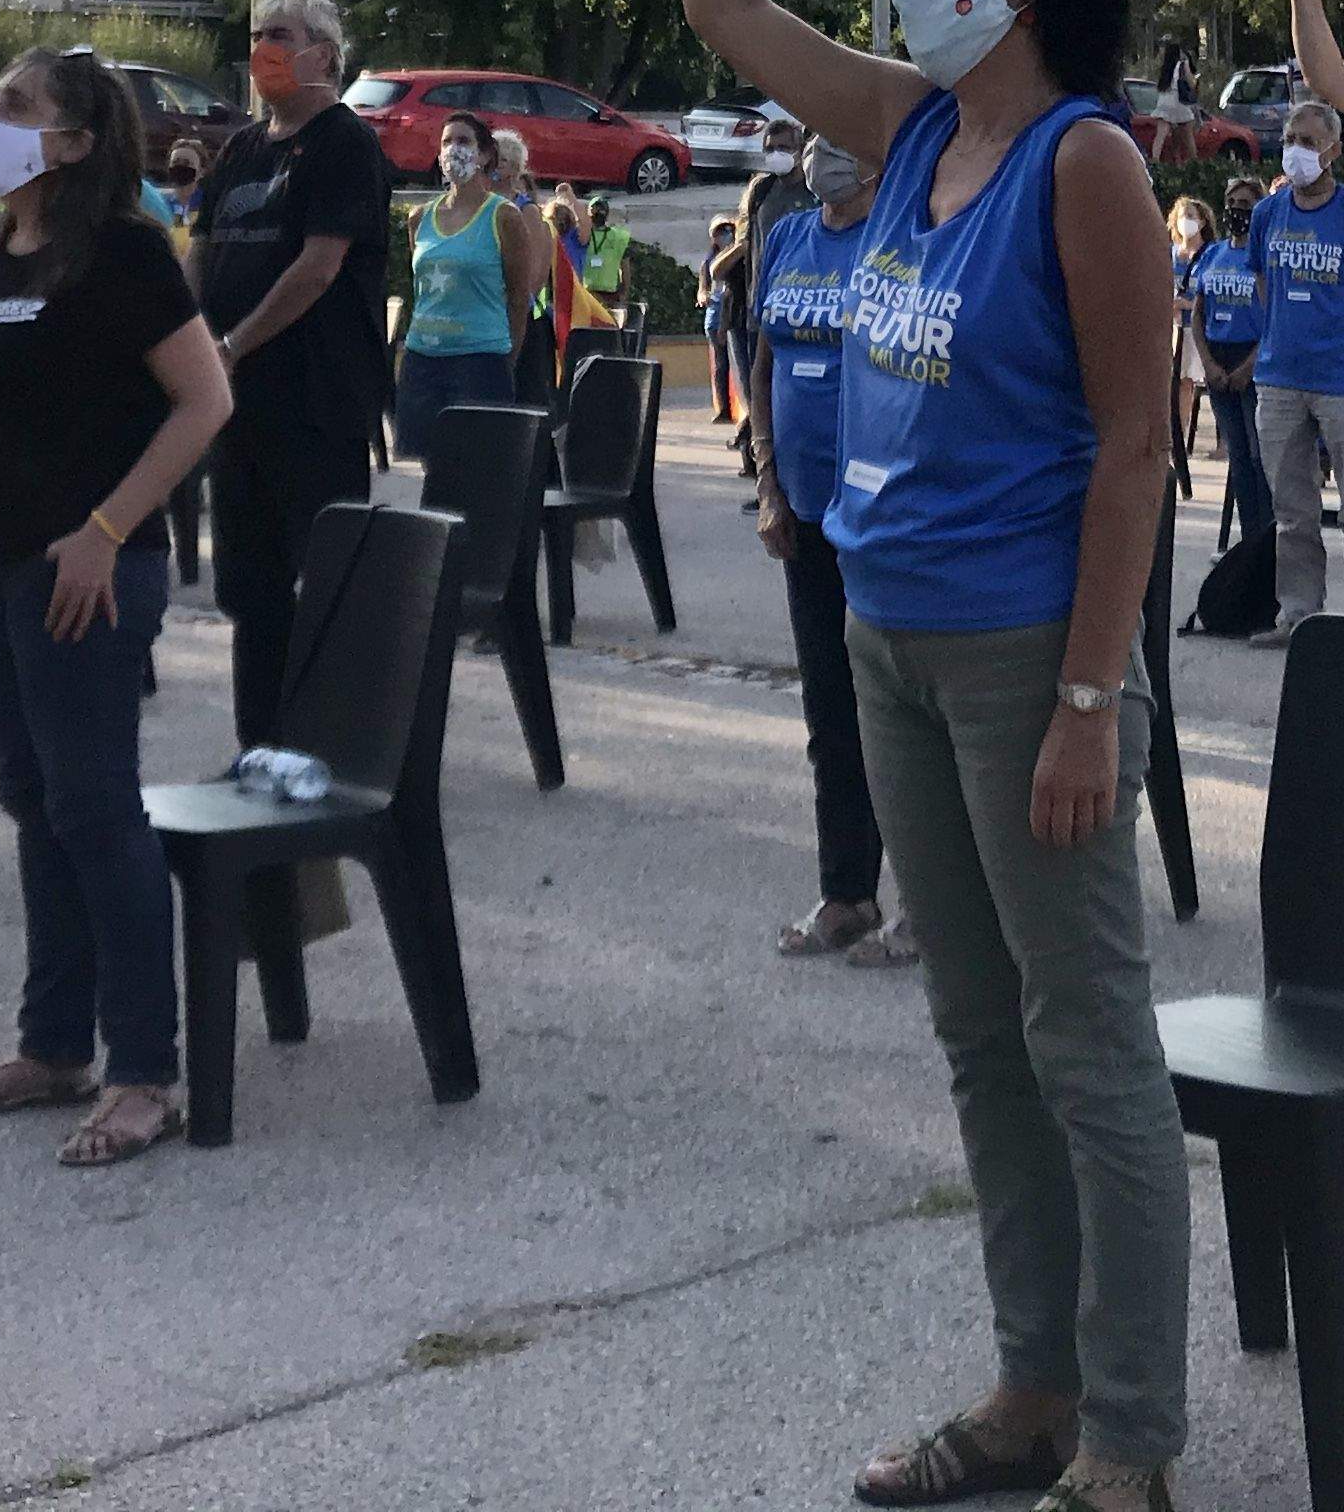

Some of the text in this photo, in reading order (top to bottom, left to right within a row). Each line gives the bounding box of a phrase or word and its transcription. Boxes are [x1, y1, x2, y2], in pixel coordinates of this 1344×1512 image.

[1279, 252, 1341, 274] FUTUR
[1205, 280, 1254, 298] FUTUR
[769, 302, 843, 328] FUTU
[852, 299, 953, 360] FUTUR
[869, 345, 951, 388] MILLOR
